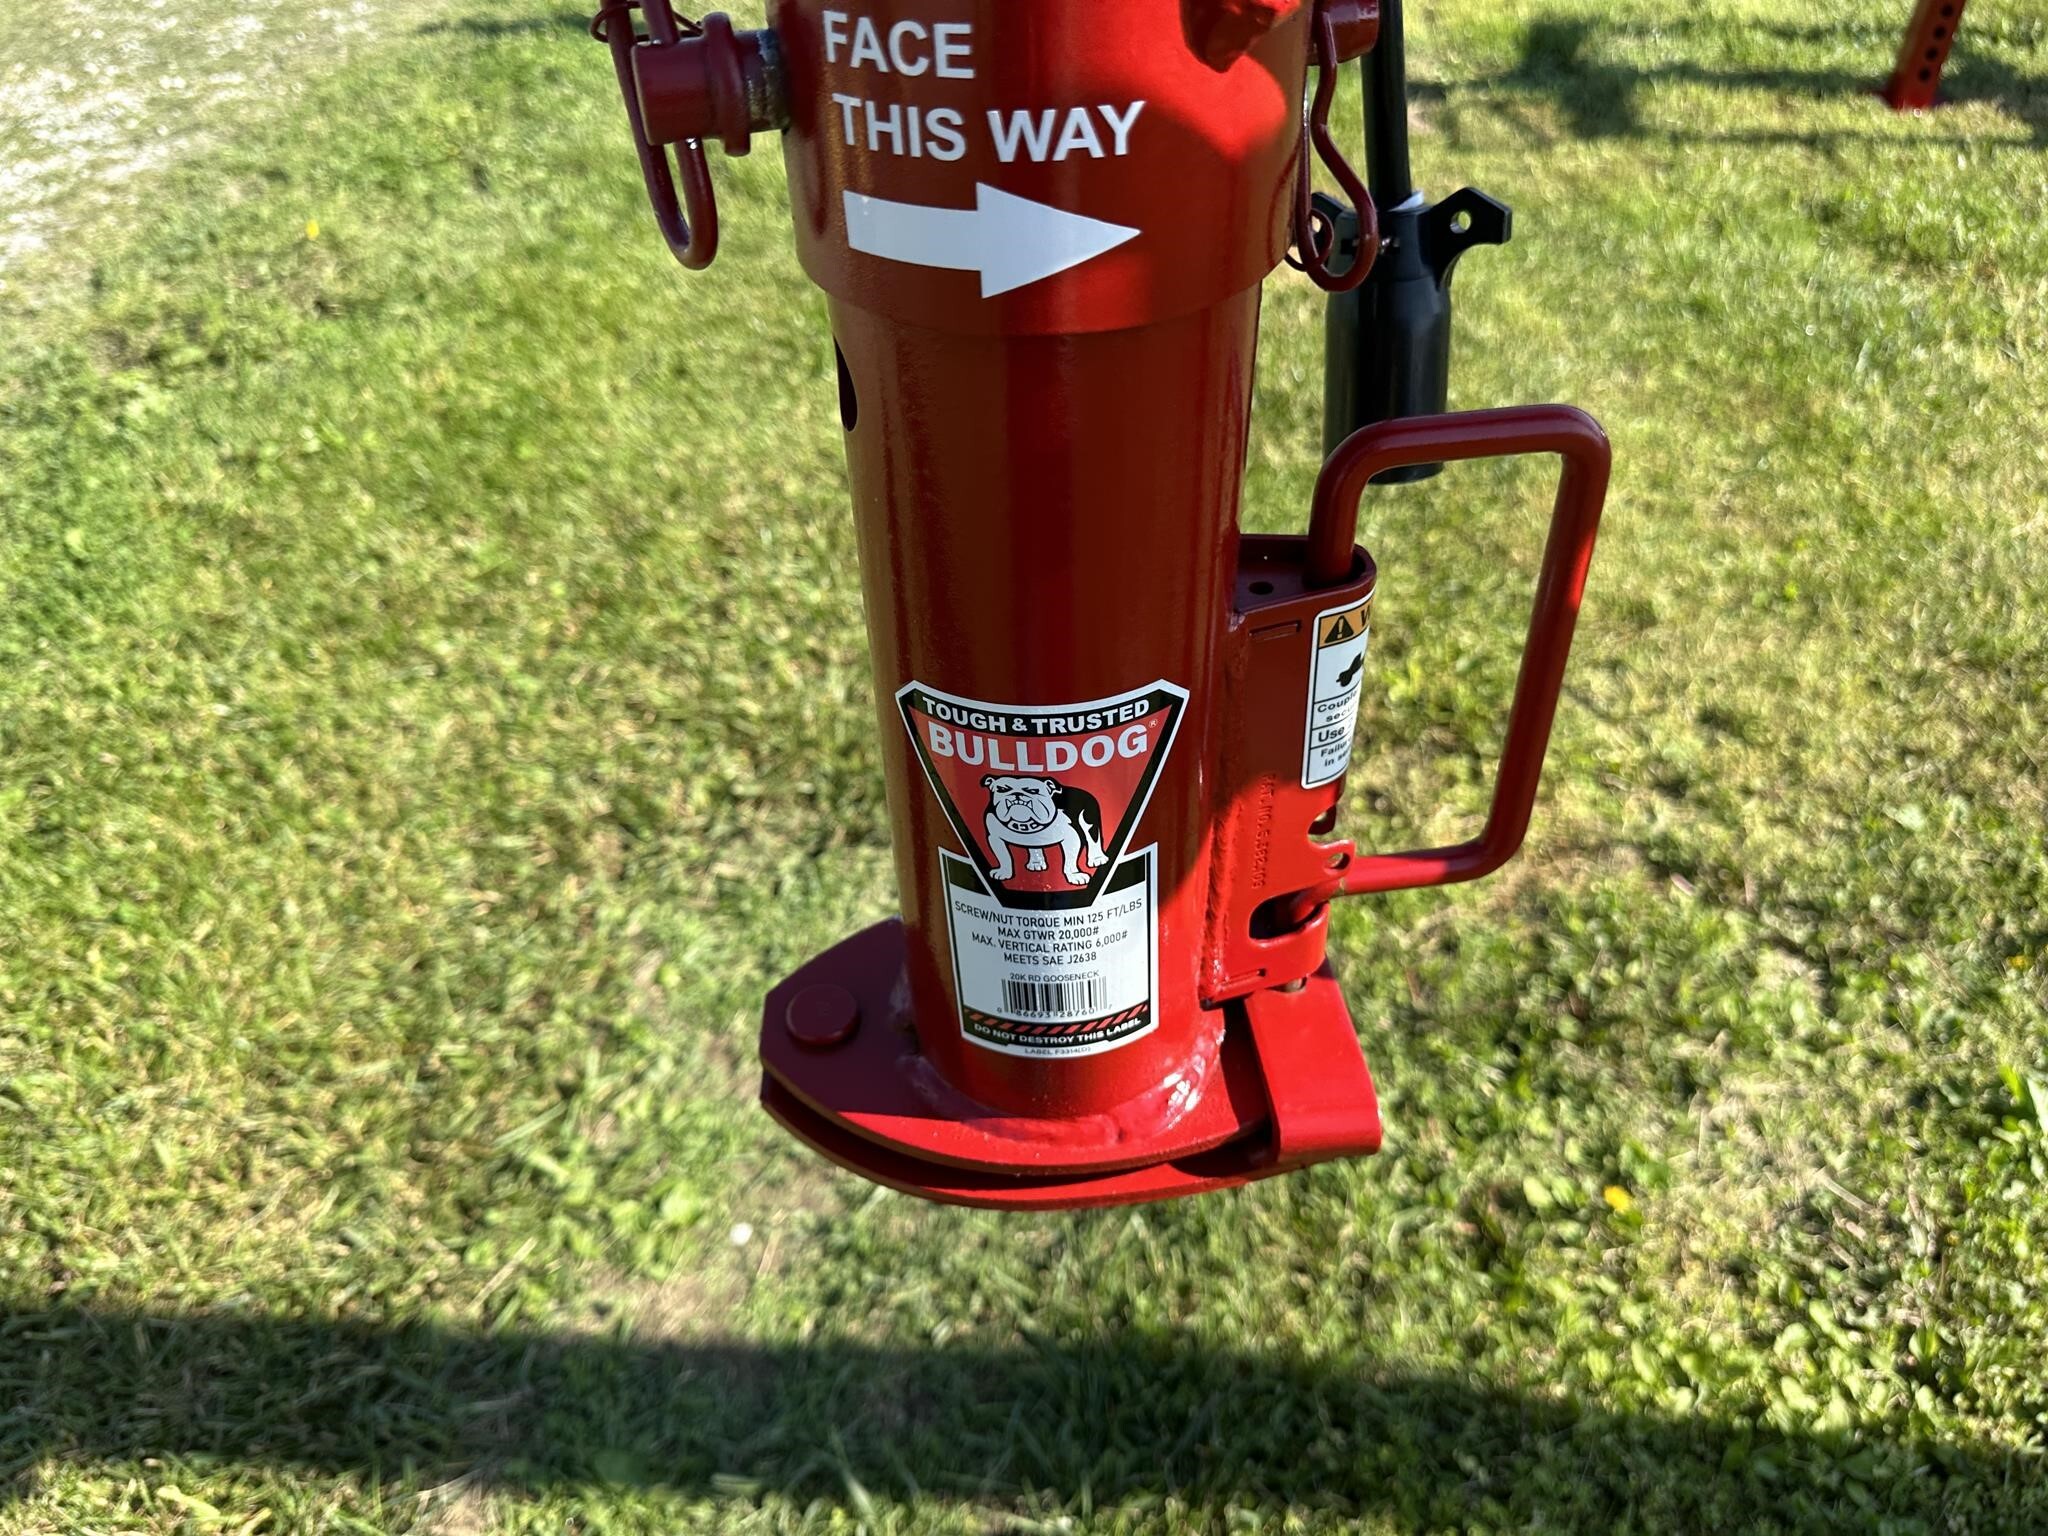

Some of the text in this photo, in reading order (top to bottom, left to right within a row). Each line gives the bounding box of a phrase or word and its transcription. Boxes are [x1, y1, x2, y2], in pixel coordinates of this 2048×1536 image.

[823, 10, 975, 79] FACE
[832, 92, 1147, 162] THIS WAY
[922, 696, 1150, 735] TOUGH & TRUSTED
[1318, 727, 1345, 742] Use
[955, 898, 1142, 928] SCREW/NUT TORQUE MIN 125 FT/LBS
[972, 930, 1128, 953] MAX. VERTICAL RATING 6,000#
[997, 926, 1100, 941] MAX GTWR 20,000#
[1004, 951, 1097, 966] MEETS SAE J2638
[1010, 970, 1100, 983] 20K RD GOOSENECK
[974, 1017, 1142, 1044] DO NOT DESTROY THIS LABEL
[1025, 1047, 1053, 1055] LABEL
